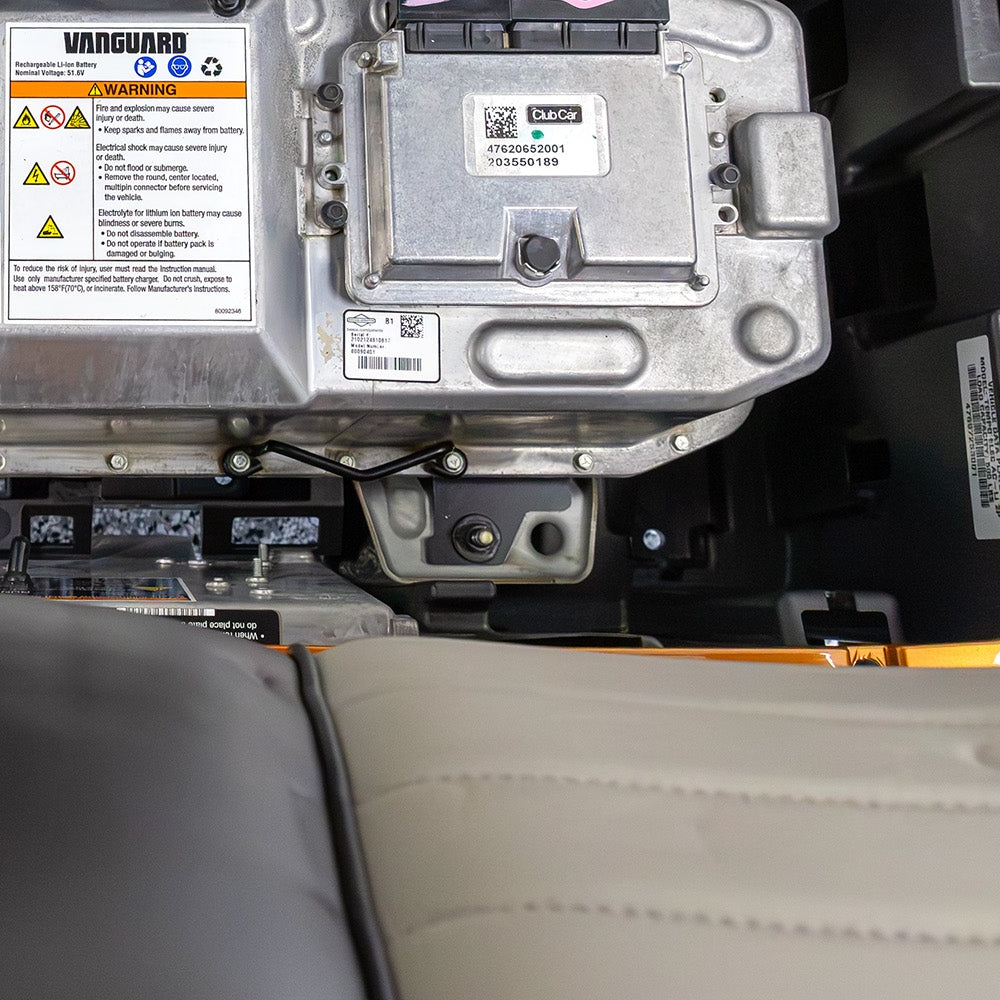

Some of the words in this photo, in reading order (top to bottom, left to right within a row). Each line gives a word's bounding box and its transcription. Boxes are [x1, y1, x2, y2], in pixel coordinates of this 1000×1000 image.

[64, 32, 187, 54] VANGUARD
[104, 84, 177, 96] WARNING
[96, 104, 108, 112] Fire
[124, 105, 155, 113] explosion
[532, 108, 557, 120] Club
[558, 108, 578, 120] Car
[104, 126, 121, 135] Keep
[122, 126, 144, 134] sparks
[220, 127, 244, 135] battery.
[209, 144, 227, 153] injury
[487, 144, 565, 153] 47620652001
[487, 158, 559, 166] 203550189
[154, 164, 188, 172] submerge.
[192, 184, 222, 192] servicing
[98, 209, 133, 218] Electrolyte
[182, 209, 205, 218] battery
[98, 219, 130, 227] blindness
[164, 240, 188, 248] battery
[149, 250, 175, 258] bulging.
[28, 275, 40, 283] only
[85, 275, 111, 283] specified
[113, 276, 134, 284] battery
[135, 276, 159, 284] charger.
[209, 620, 231, 630] place
[247, 622, 257, 630] do
[234, 632, 258, 640] When
